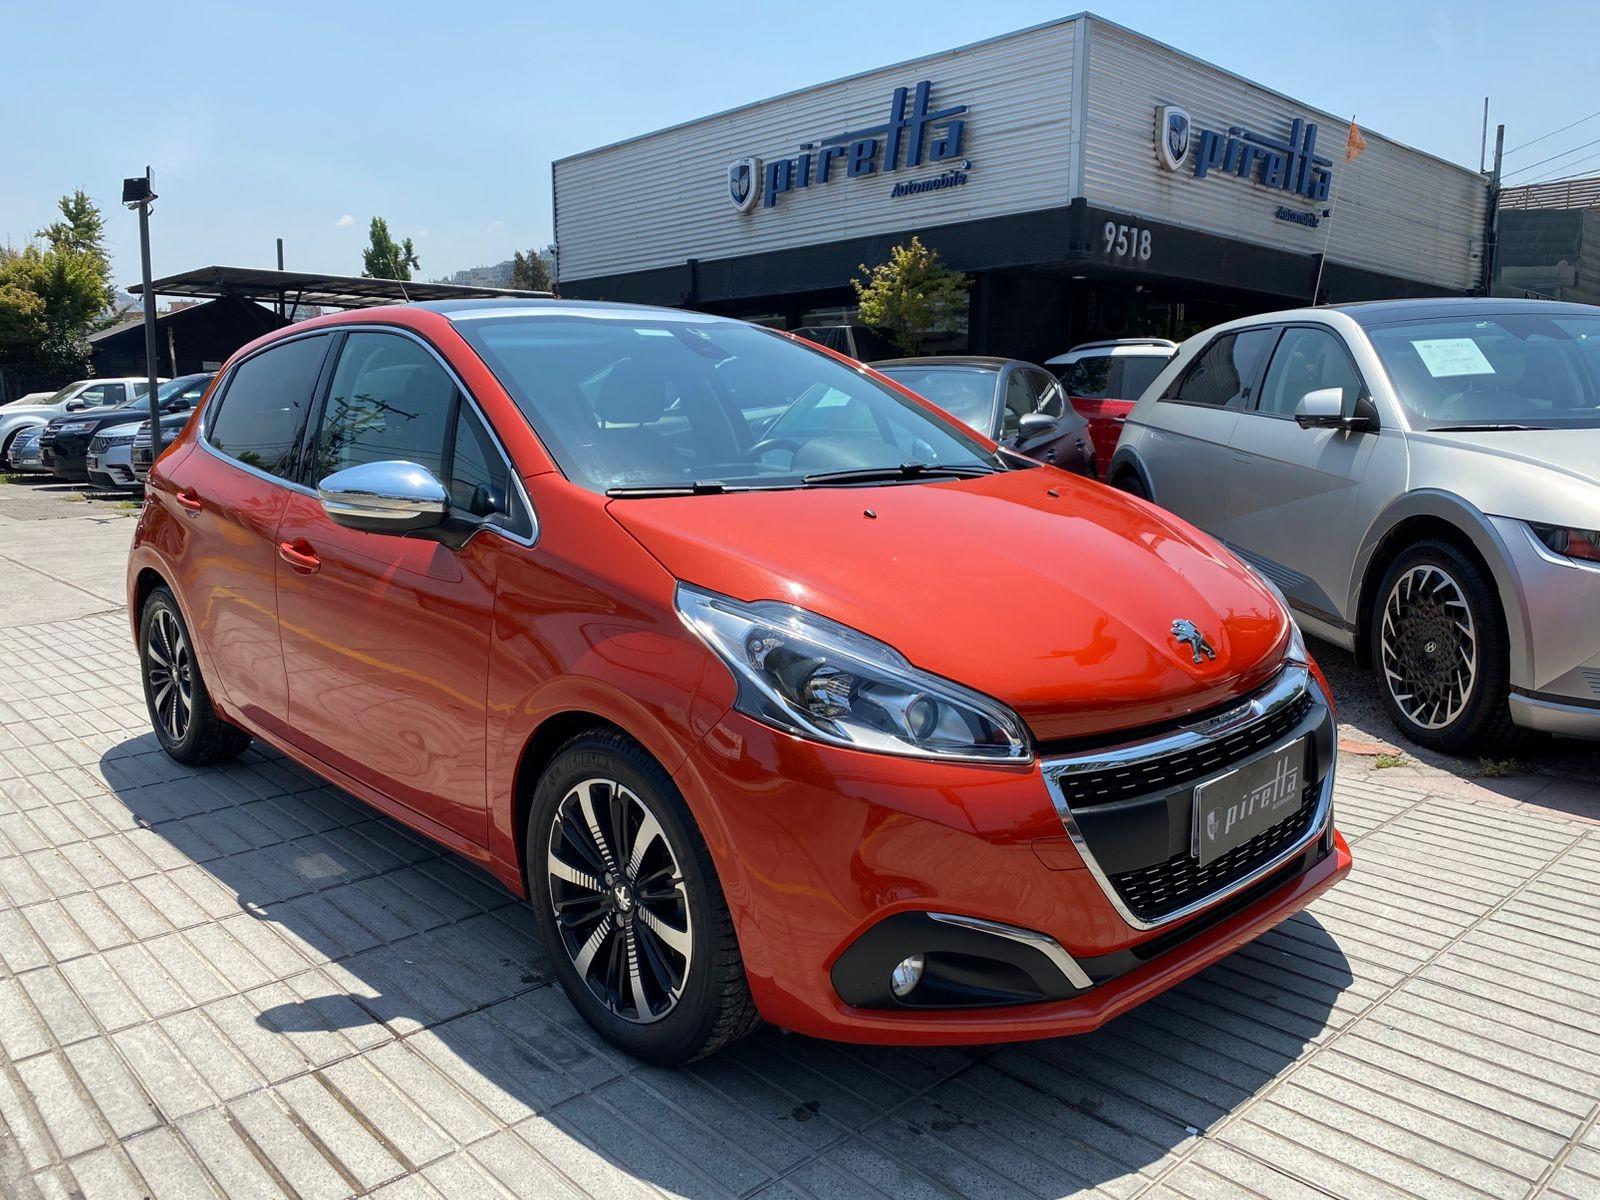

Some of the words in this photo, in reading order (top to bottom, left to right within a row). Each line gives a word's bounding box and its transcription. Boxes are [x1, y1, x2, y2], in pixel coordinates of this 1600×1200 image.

[764, 80, 967, 208] piretta
[1193, 118, 1333, 201] piretta
[1103, 221, 1152, 261] 9518
[1224, 756, 1299, 834] piretta
